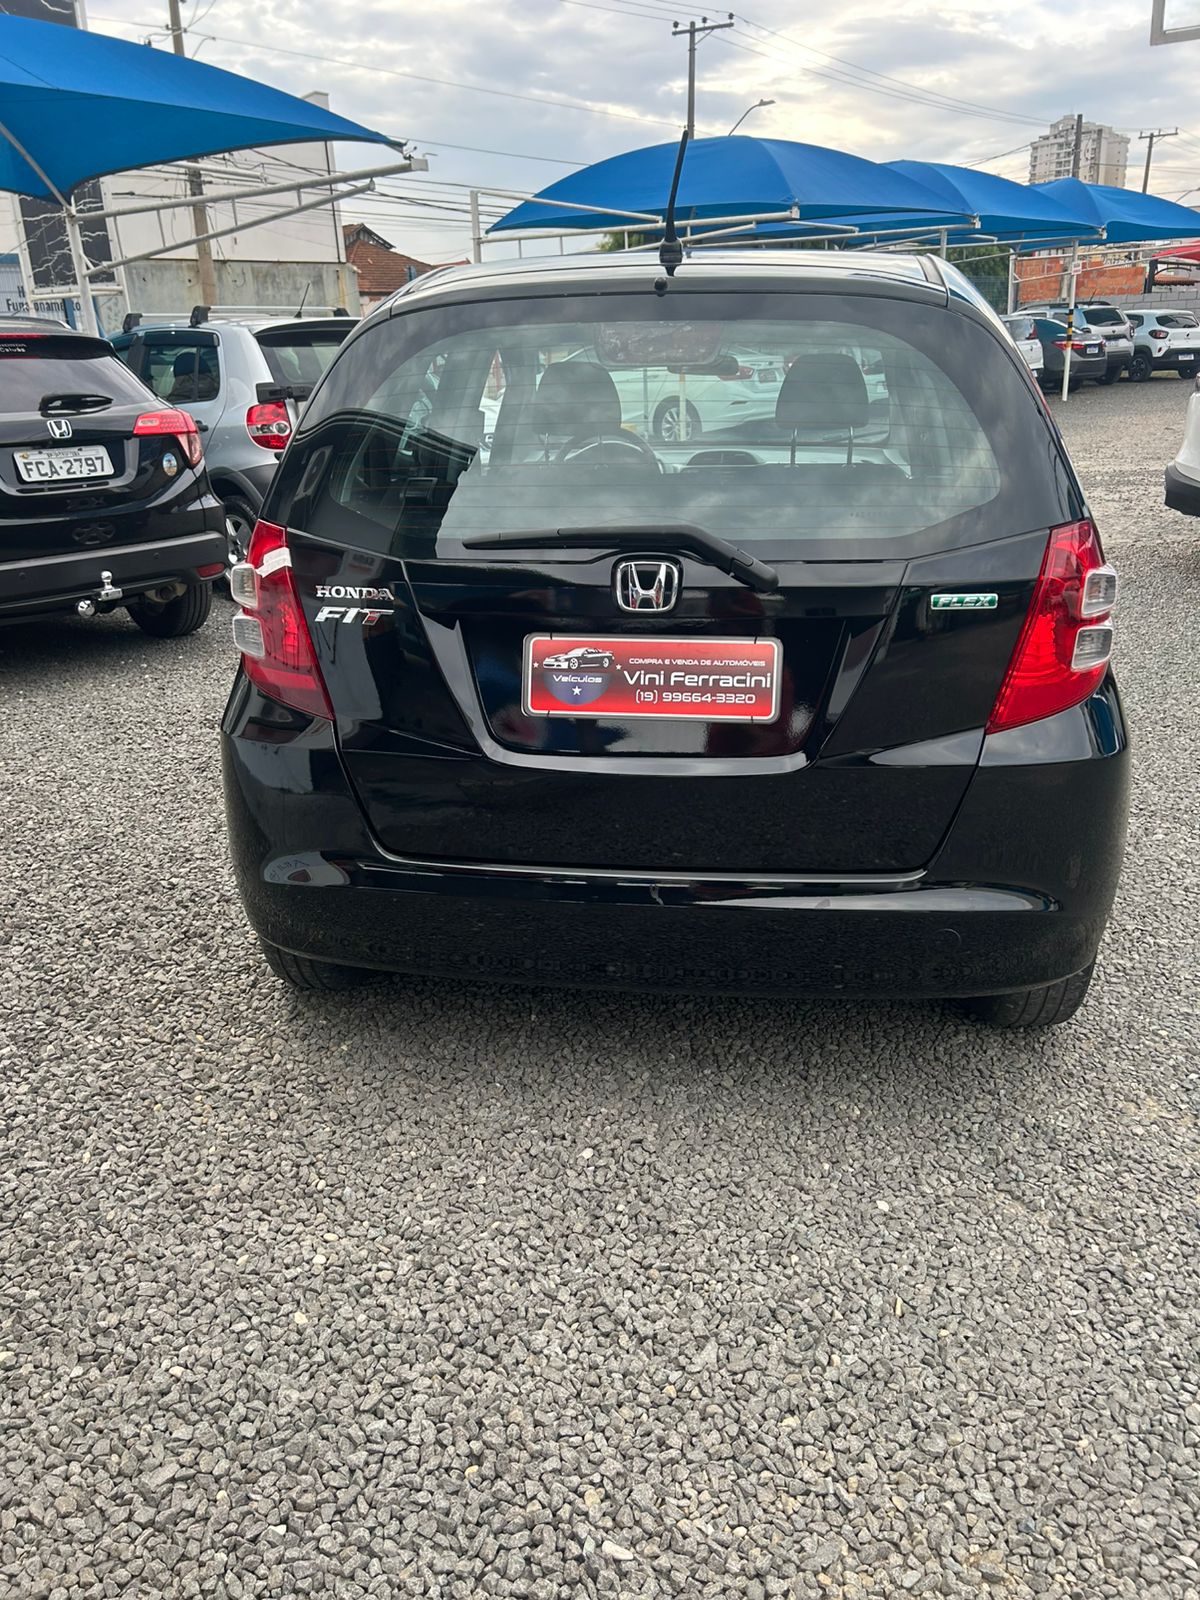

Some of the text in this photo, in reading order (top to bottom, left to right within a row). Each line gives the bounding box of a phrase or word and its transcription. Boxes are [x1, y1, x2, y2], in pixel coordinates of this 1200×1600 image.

[315, 585, 395, 600] HONDA
[937, 596, 992, 607] FLEX
[315, 606, 395, 626] FIT
[712, 658, 766, 667] AUTOMÓVEIS
[553, 674, 603, 683] Veículos
[623, 670, 771, 688] Vini Ferracini
[635, 689, 756, 704] (19) 99664-3320
